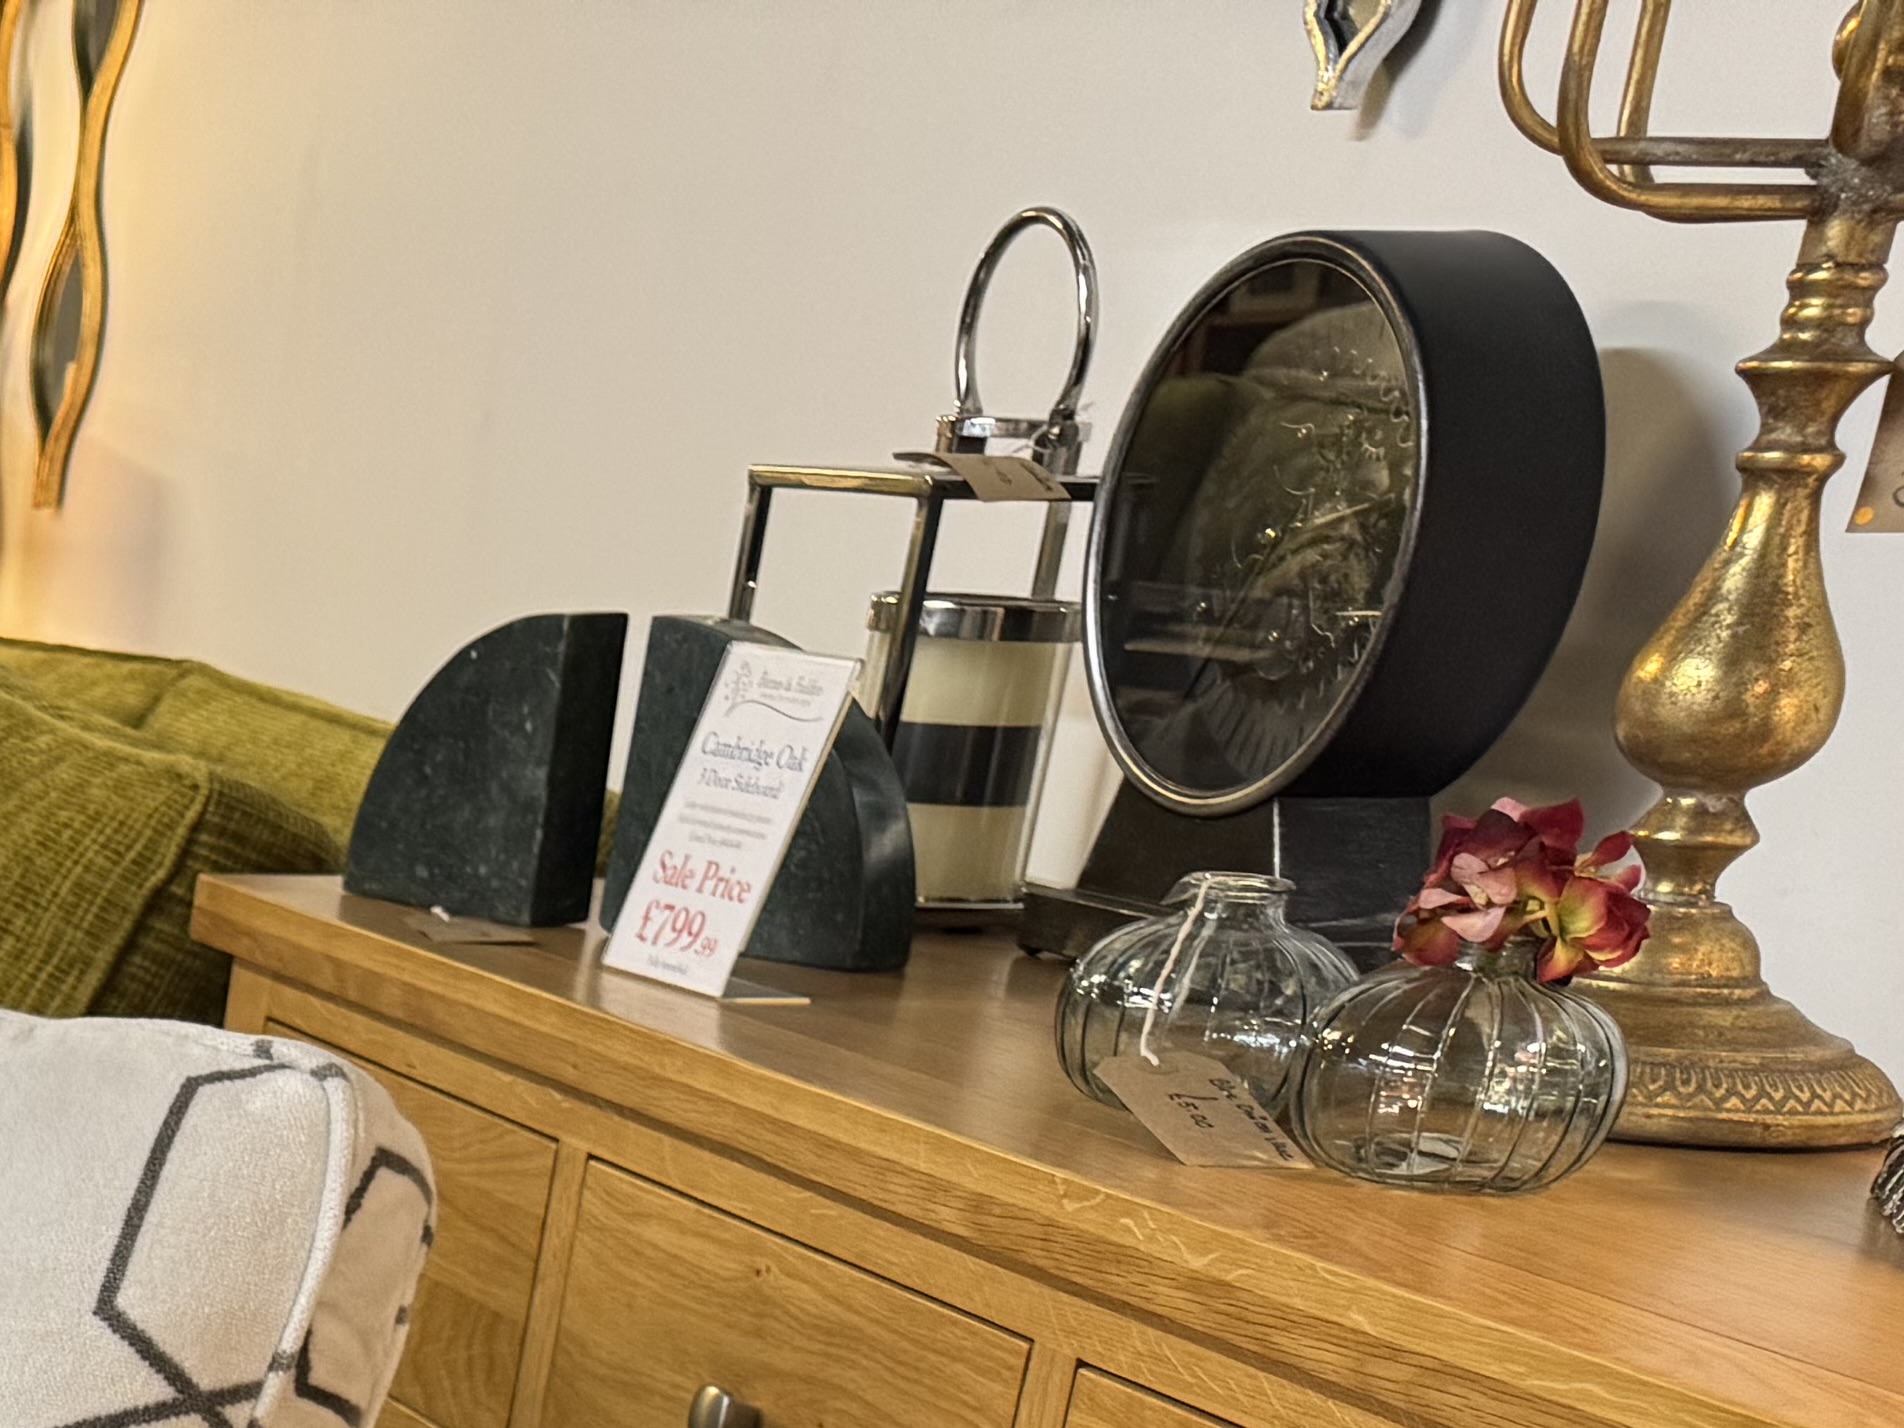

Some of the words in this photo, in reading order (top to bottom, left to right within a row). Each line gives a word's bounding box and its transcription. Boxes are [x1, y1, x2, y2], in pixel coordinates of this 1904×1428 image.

[701, 731, 773, 771] Cambridge
[776, 744, 809, 773] Oak
[652, 849, 695, 890] Sale
[695, 860, 751, 904] Price
